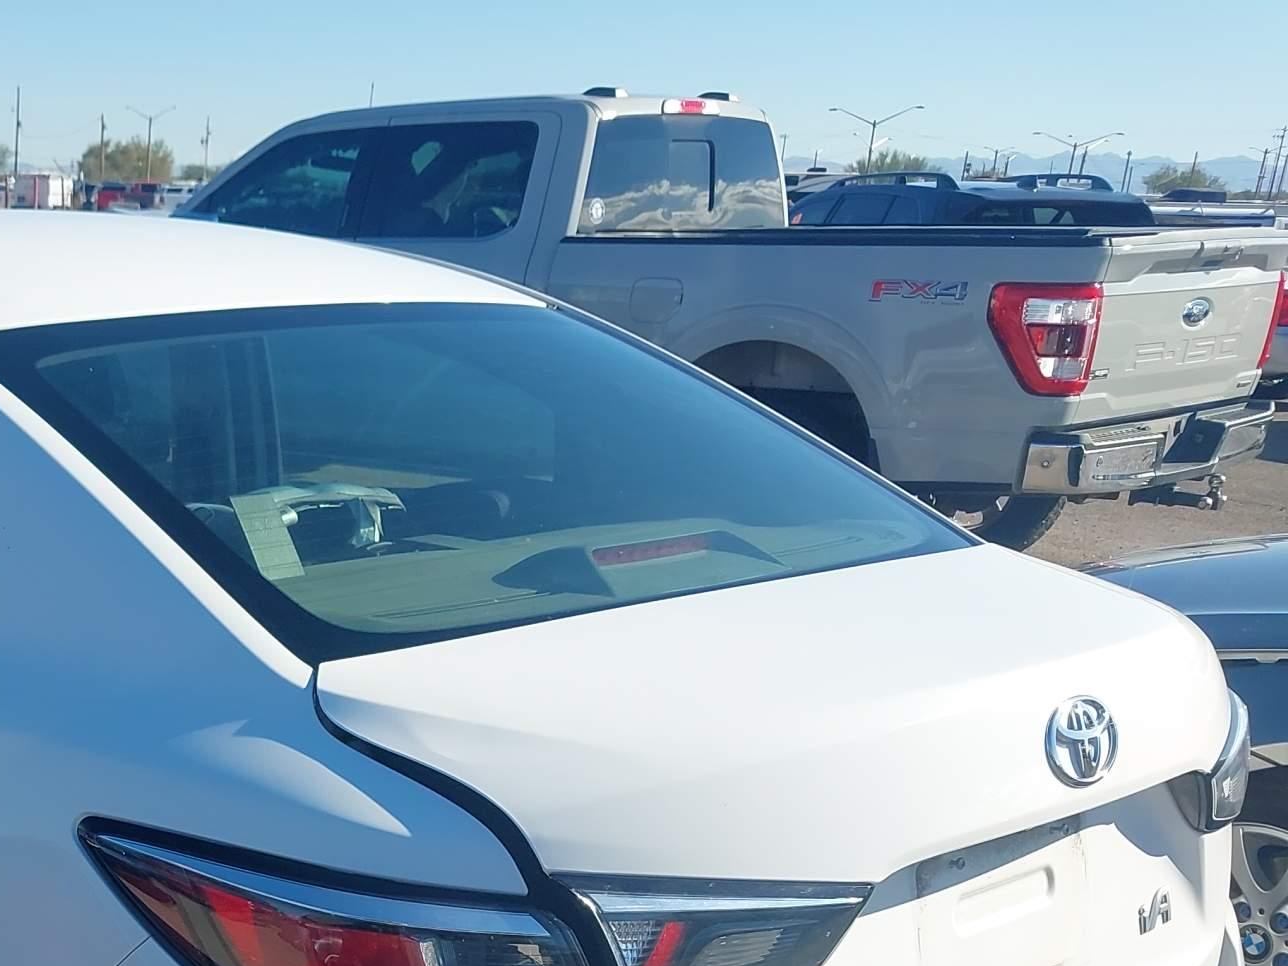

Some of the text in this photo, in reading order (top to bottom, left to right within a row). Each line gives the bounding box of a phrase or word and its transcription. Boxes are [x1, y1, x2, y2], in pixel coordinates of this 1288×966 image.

[868, 279, 969, 302] FX4
[1124, 332, 1241, 372] F-150
[1137, 886, 1172, 936] iA
